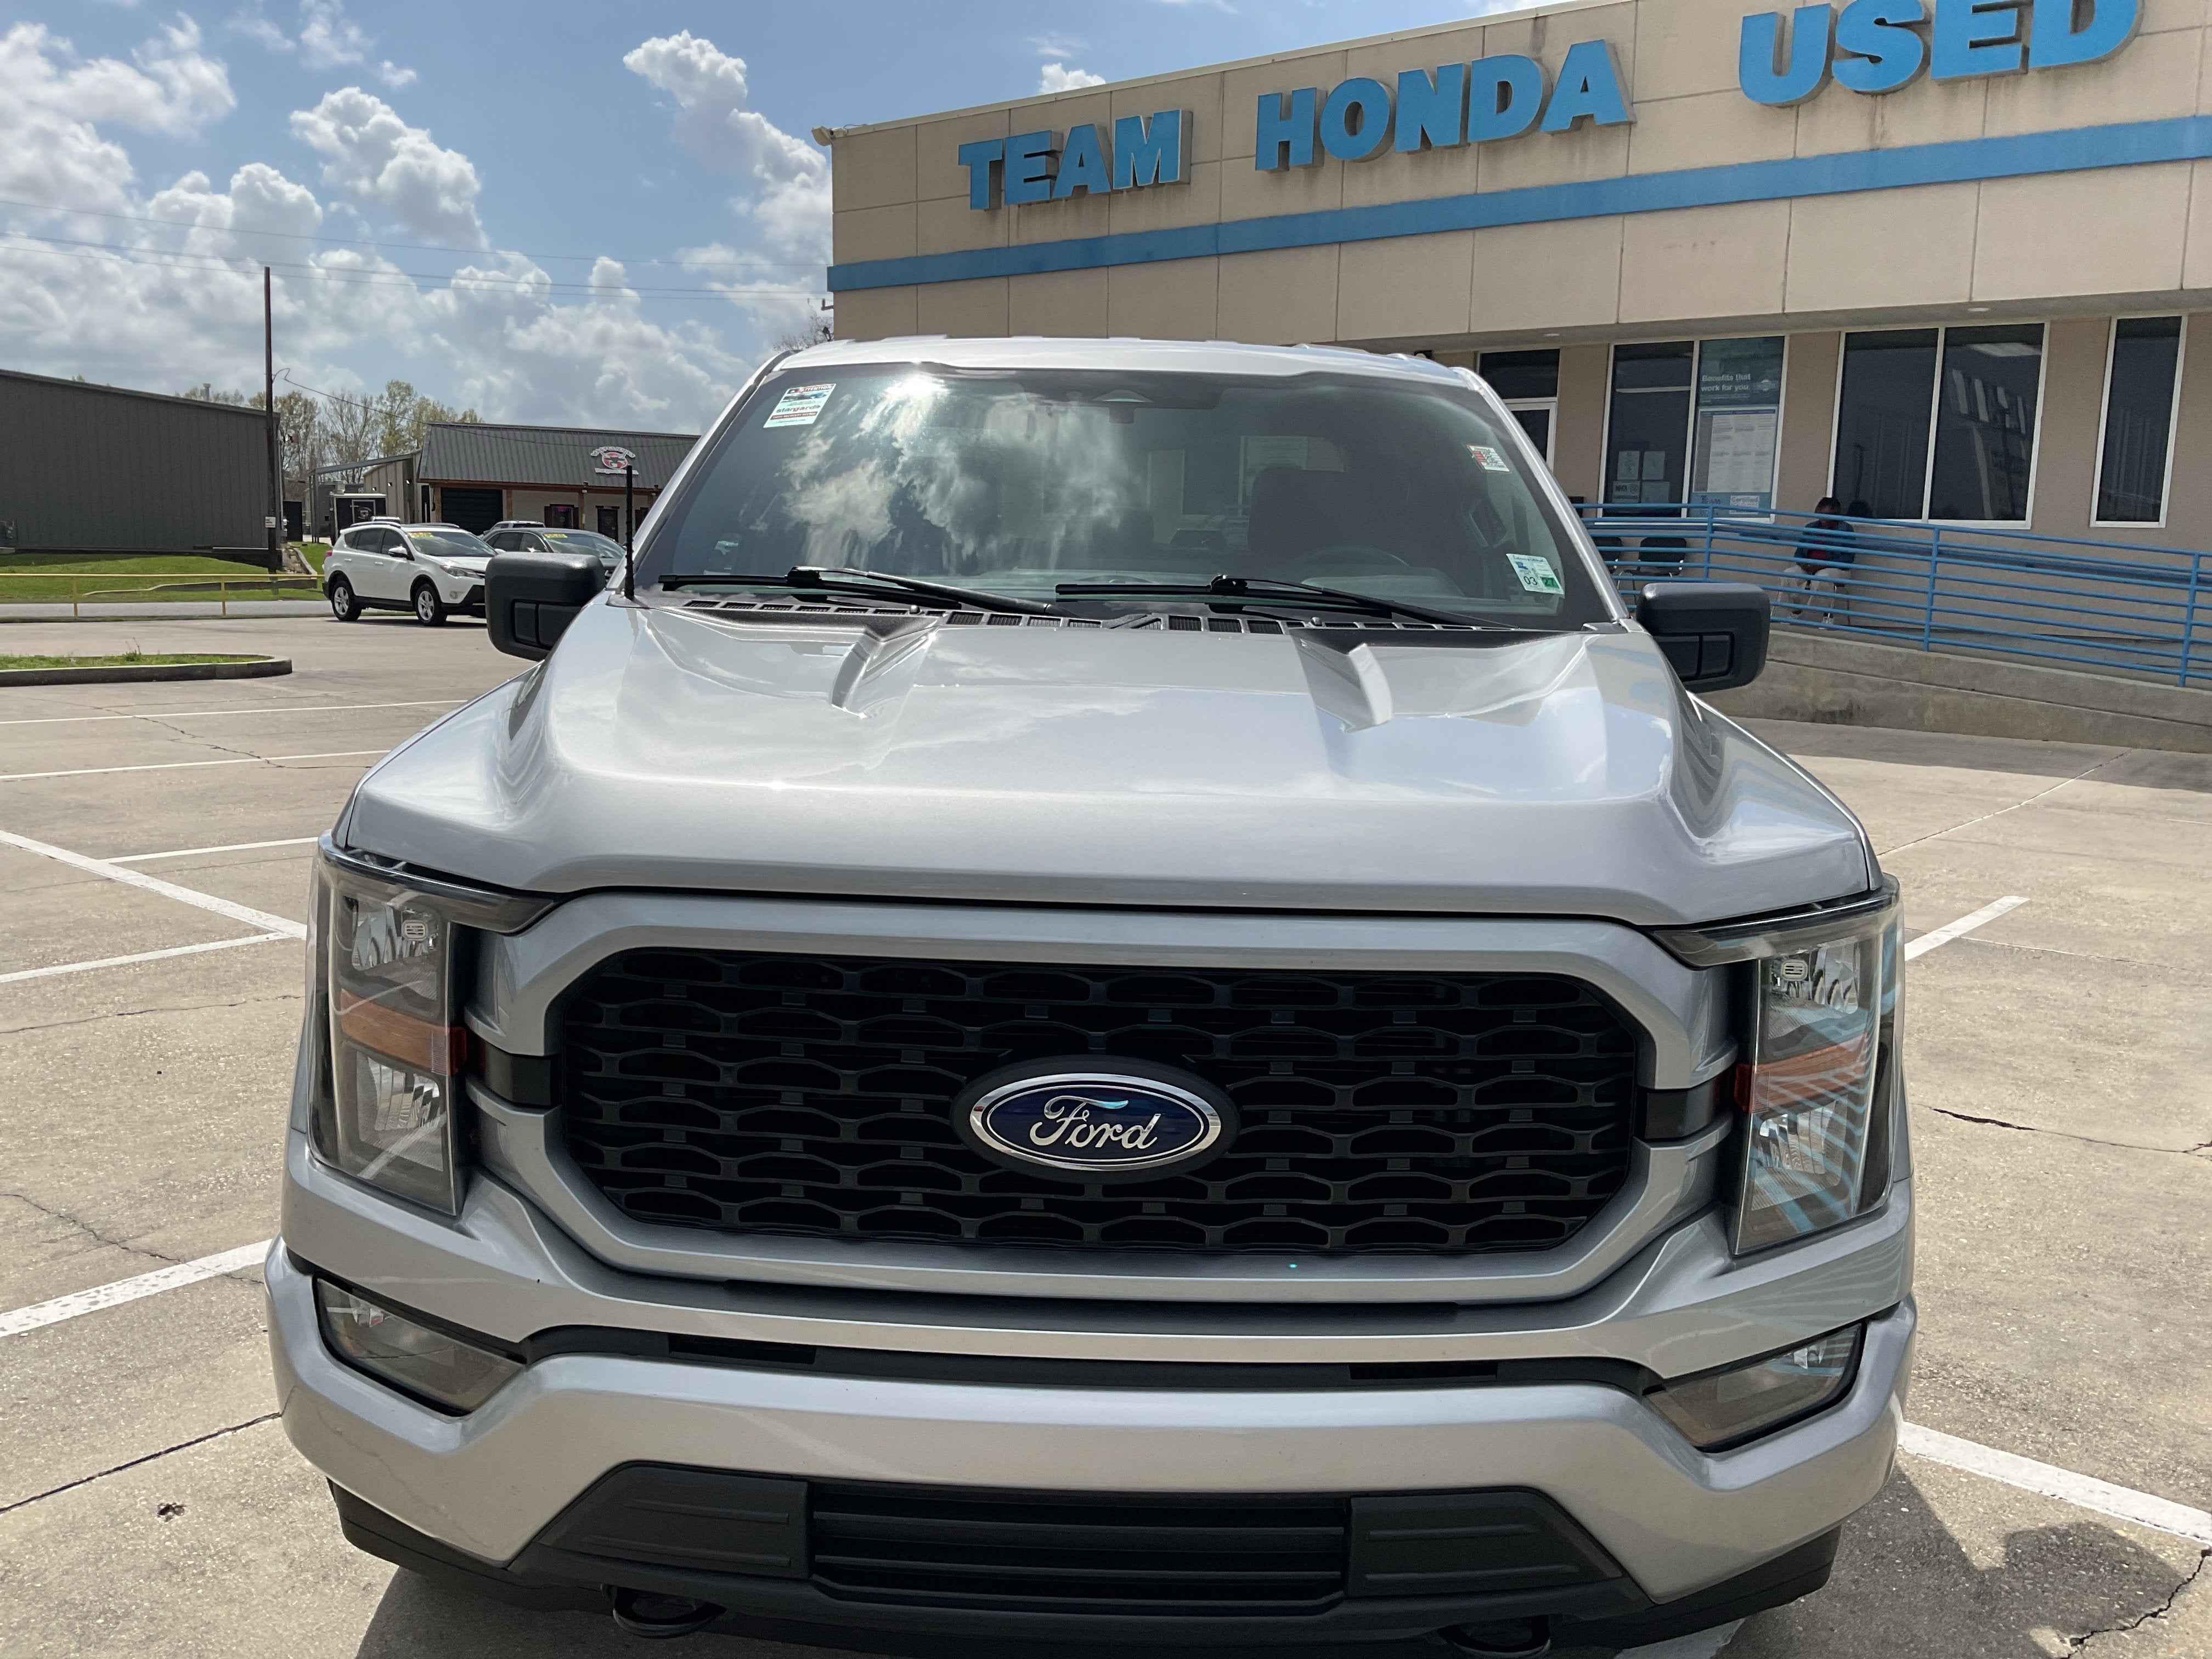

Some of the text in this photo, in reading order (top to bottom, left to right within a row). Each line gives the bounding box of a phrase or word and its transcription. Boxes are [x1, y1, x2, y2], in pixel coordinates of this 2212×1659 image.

[959, 0, 2145, 211] TEAM HONDA USED
[1523, 576, 1555, 586] 03 27
[1029, 1095, 1161, 1149] Ford
